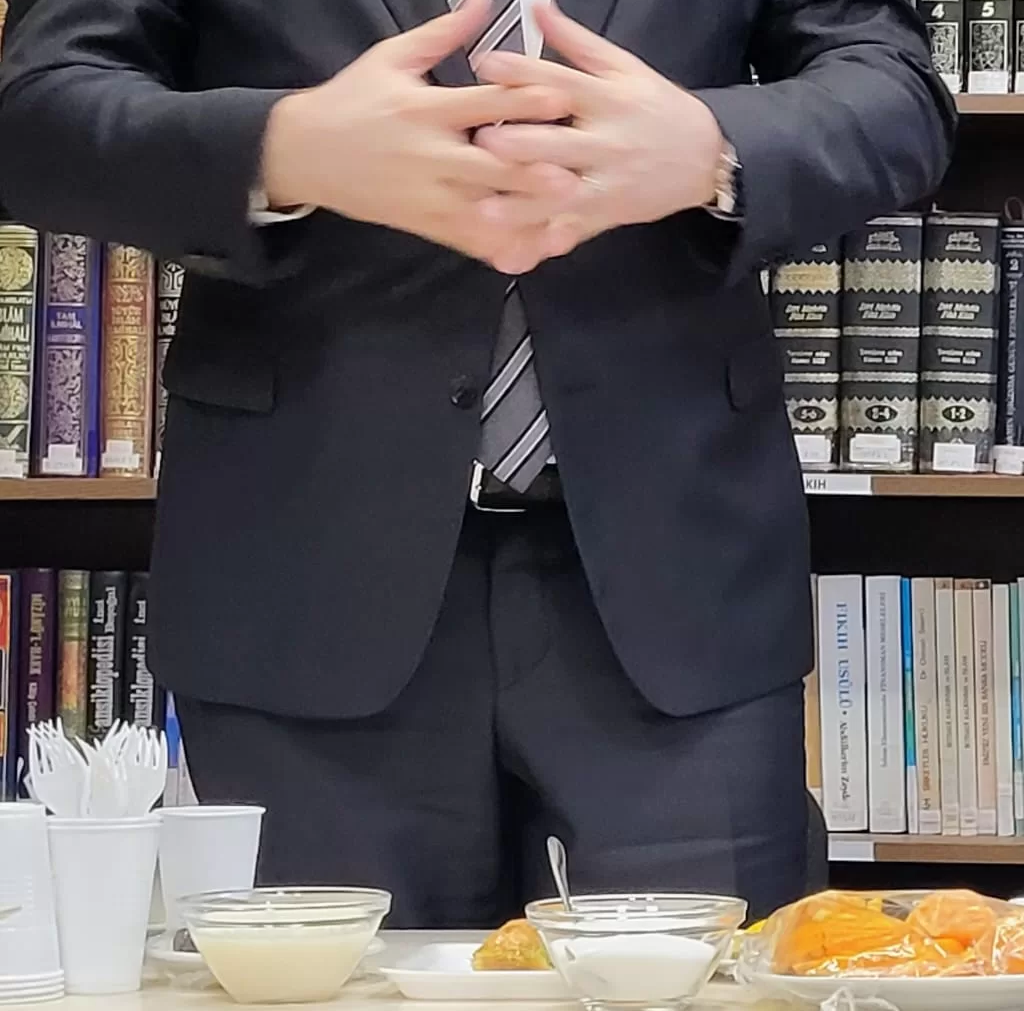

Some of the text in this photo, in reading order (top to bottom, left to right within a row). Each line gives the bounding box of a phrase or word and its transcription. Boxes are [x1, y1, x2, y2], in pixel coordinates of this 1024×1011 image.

[932, 3, 945, 19] 4
[981, 2, 995, 17] 5
[1009, 258, 1019, 271] 2
[950, 407, 966, 419] 1-2
[806, 479, 827, 489] KIH
[837, 602, 848, 650] FIKIH
[90, 635, 119, 727] ansiklopedisi
